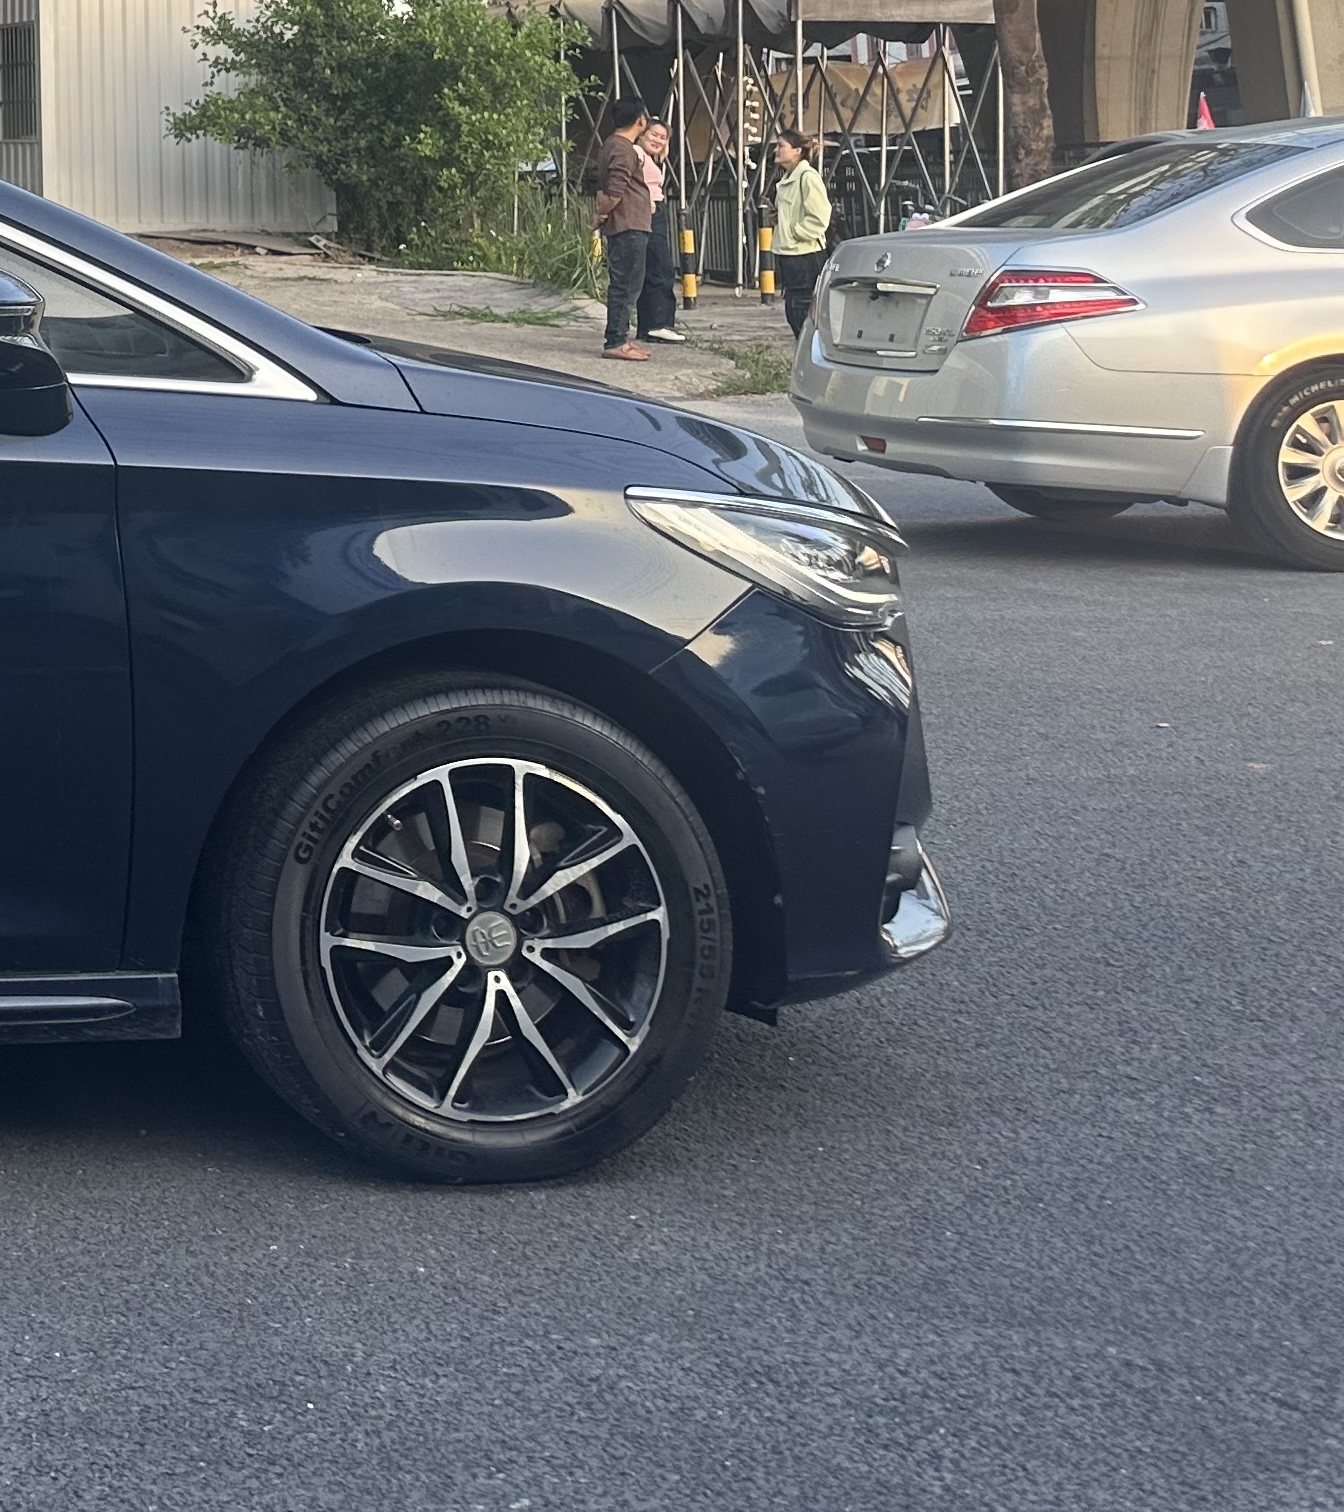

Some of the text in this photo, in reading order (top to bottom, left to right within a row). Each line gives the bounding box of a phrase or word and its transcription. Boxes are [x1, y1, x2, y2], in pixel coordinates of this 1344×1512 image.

[294, 729, 425, 866] GitiComfort
[436, 714, 492, 737] 228
[692, 883, 718, 980] 215/55
